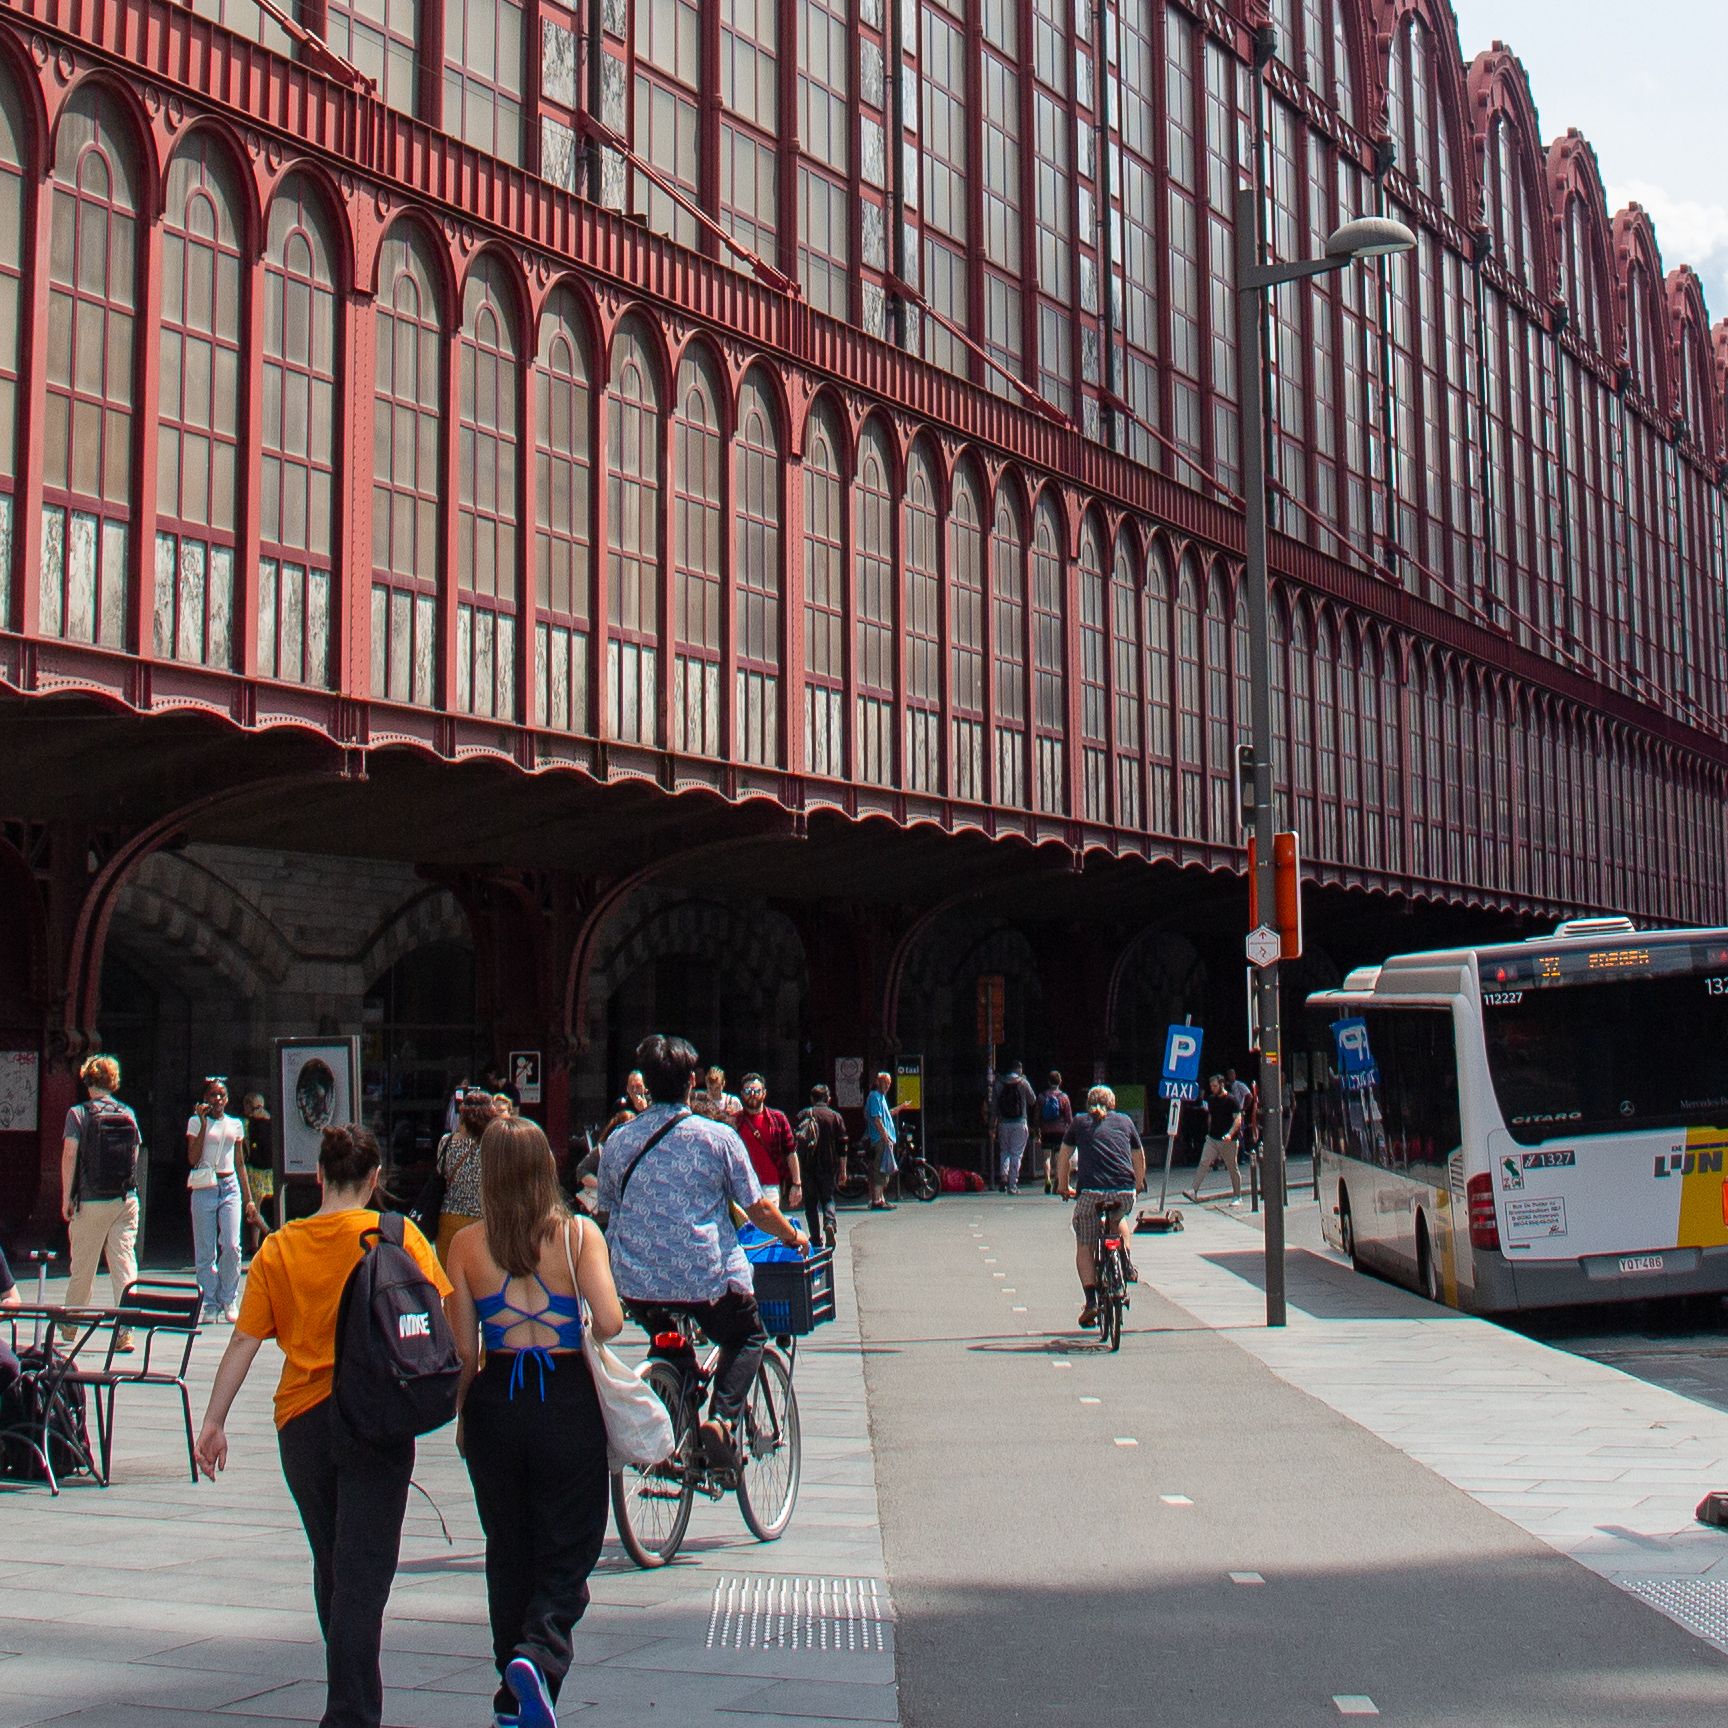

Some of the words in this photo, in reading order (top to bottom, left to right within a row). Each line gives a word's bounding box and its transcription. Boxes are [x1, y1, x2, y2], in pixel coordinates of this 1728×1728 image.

[1484, 992, 1523, 1006] 112227
[1168, 1034, 1197, 1072] P
[1165, 1081, 1199, 1101] TAXI
[1511, 1111, 1583, 1124] CITARO
[1540, 1152, 1571, 1166] 1327
[399, 1312, 430, 1339] NIKE
